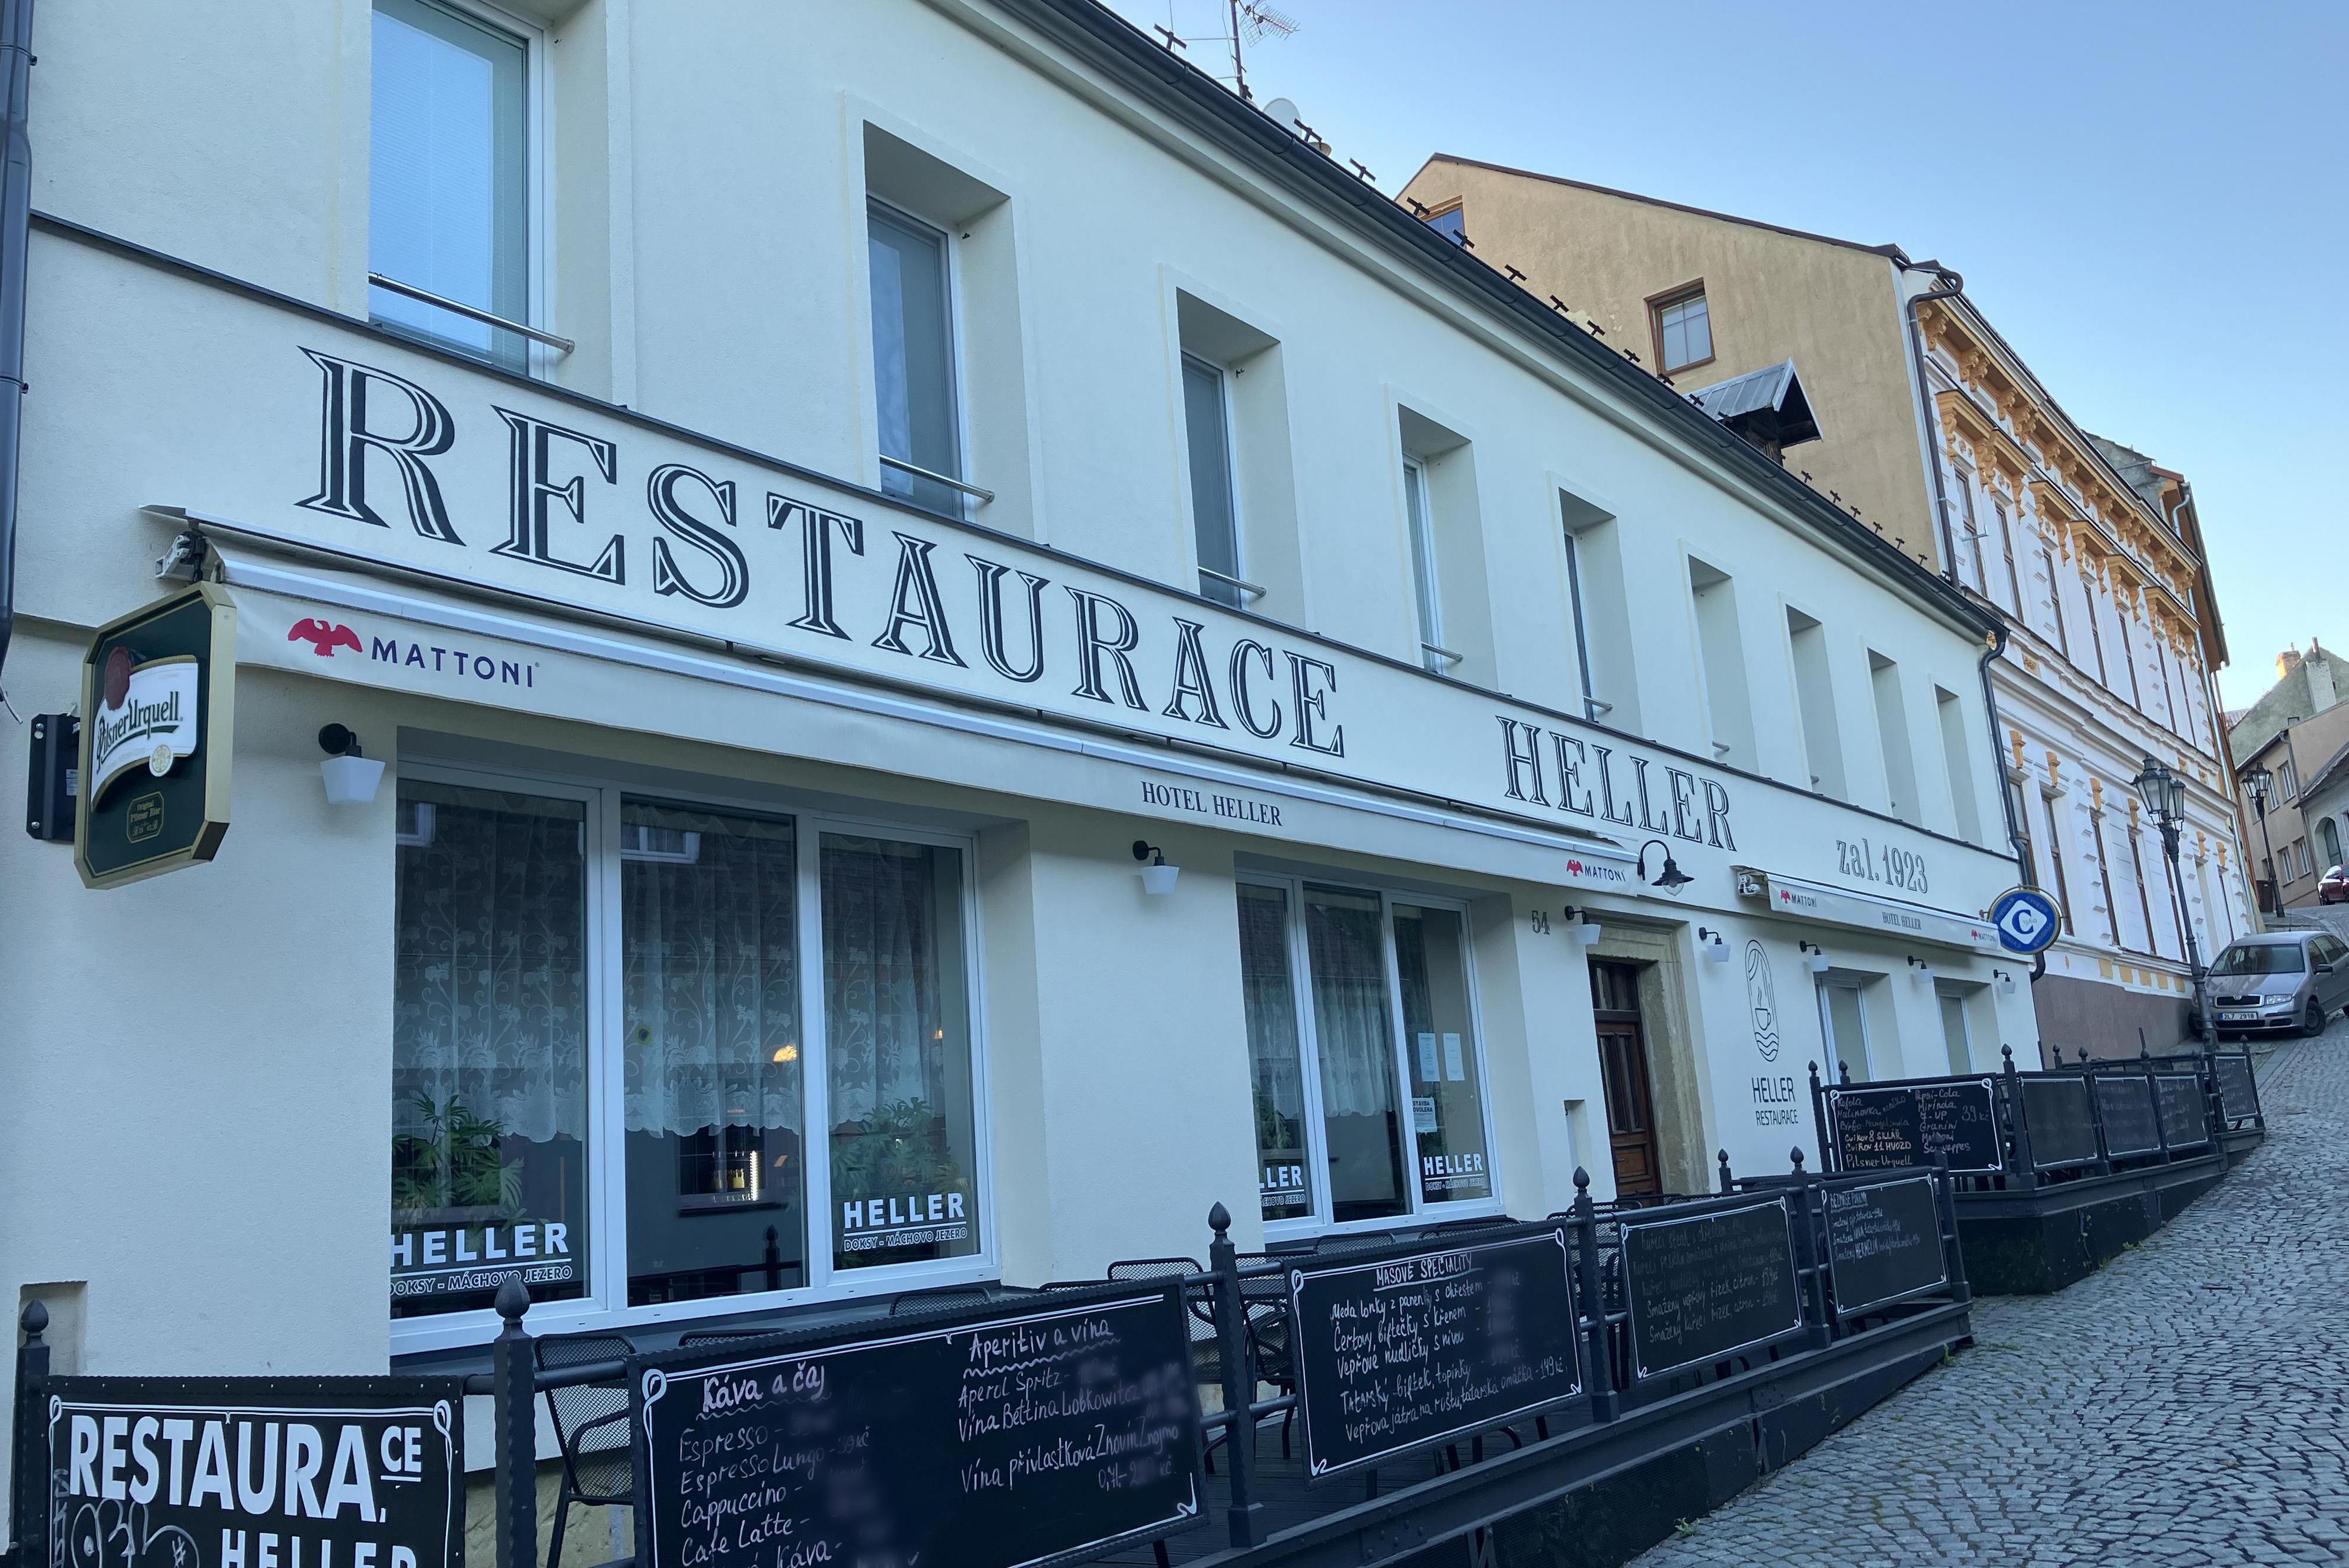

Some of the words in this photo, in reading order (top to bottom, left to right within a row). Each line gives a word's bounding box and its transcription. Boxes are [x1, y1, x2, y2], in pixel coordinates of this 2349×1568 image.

[295, 345, 1344, 758] RESTAURACE
[1495, 715, 1737, 852] HELLER
[372, 636, 533, 687] MATTONI
[1141, 781, 1207, 813] HOTEL
[1212, 795, 1283, 826] HELLER
[1584, 864, 1626, 882] MATTONI
[1792, 894, 1817, 908] MATTONI
[1531, 909, 1551, 935] 54
[1882, 912, 1901, 927] HOTEL
[1901, 915, 1922, 931] HELLER
[1751, 1077, 1796, 1103] HELLER
[1755, 1109, 1799, 1126] RESTAURACE
[1423, 1153, 1484, 1176] HELLER
[844, 1192, 965, 1229] HELLER
[1284, 1193, 1306, 1205] JEZERO
[390, 1222, 569, 1267] HELLER
[844, 1236, 879, 1252] DOKSY
[886, 1230, 934, 1247] MÁCHOVO
[934, 1227, 968, 1242] JEZERO
[524, 1265, 573, 1283] JEZERO
[969, 1326, 1047, 1368] Aperitiv
[702, 1374, 764, 1413] Káva
[772, 1375, 788, 1395] a
[792, 1361, 831, 1401] čaj
[958, 1375, 1010, 1417] Aperol
[680, 1425, 769, 1467] Espresso
[962, 1458, 1004, 1494] Vína
[680, 1480, 787, 1531] Cappuccino
[738, 1511, 794, 1549] Latte
